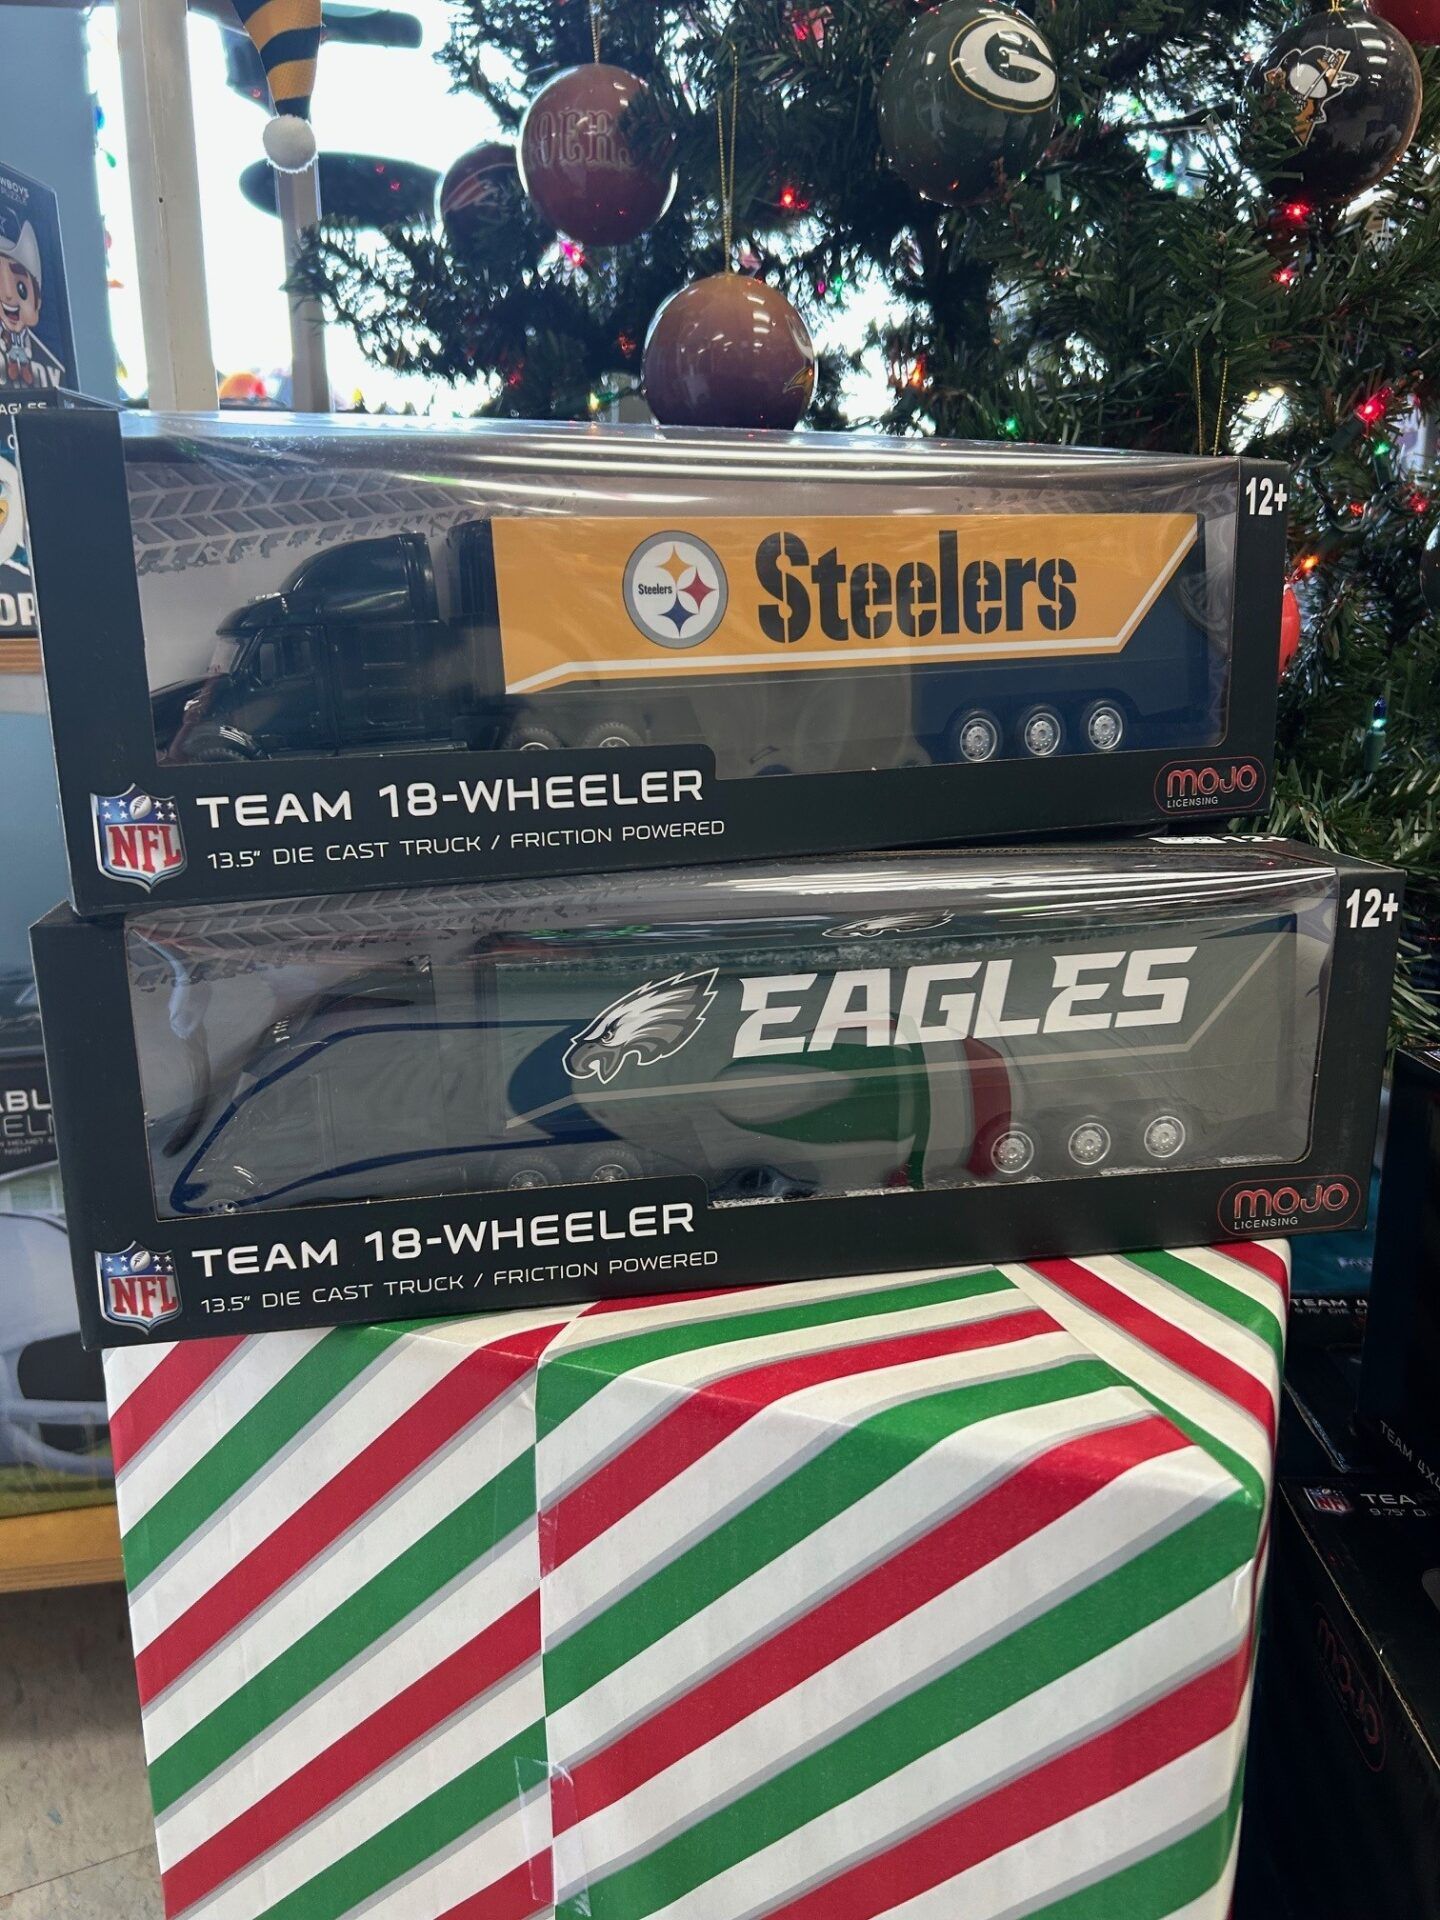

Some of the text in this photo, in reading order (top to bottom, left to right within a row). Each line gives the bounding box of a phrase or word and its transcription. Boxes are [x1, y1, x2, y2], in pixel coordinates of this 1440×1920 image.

[1245, 476, 1288, 516] 12+
[637, 582, 673, 596] Steelers
[755, 529, 1077, 644] Steelers
[195, 769, 703, 828] TEAM 18-WHEELER
[1167, 796, 1219, 809] LICENSING
[107, 824, 183, 874] NFL
[273, 846, 314, 865] DIE
[326, 841, 390, 860] CAST
[399, 836, 482, 857] TRUCK
[490, 834, 501, 850] /
[510, 827, 612, 848] FRICTION
[622, 820, 725, 842] POWERED
[1345, 887, 1399, 929] 12+
[732, 945, 1198, 1059] EAGLES
[191, 1202, 695, 1278] TEAM 18-WHEELER
[1233, 1216, 1299, 1231] LICENSING
[110, 1275, 177, 1318] NFL
[262, 1290, 301, 1309] DIE
[312, 1284, 374, 1304] CAST
[383, 1274, 464, 1296] TRUCK
[473, 1272, 484, 1288] /
[493, 1261, 598, 1286] FRICTION
[609, 1250, 718, 1275] POWERED
[1378, 1419, 1413, 1462] TEAM
